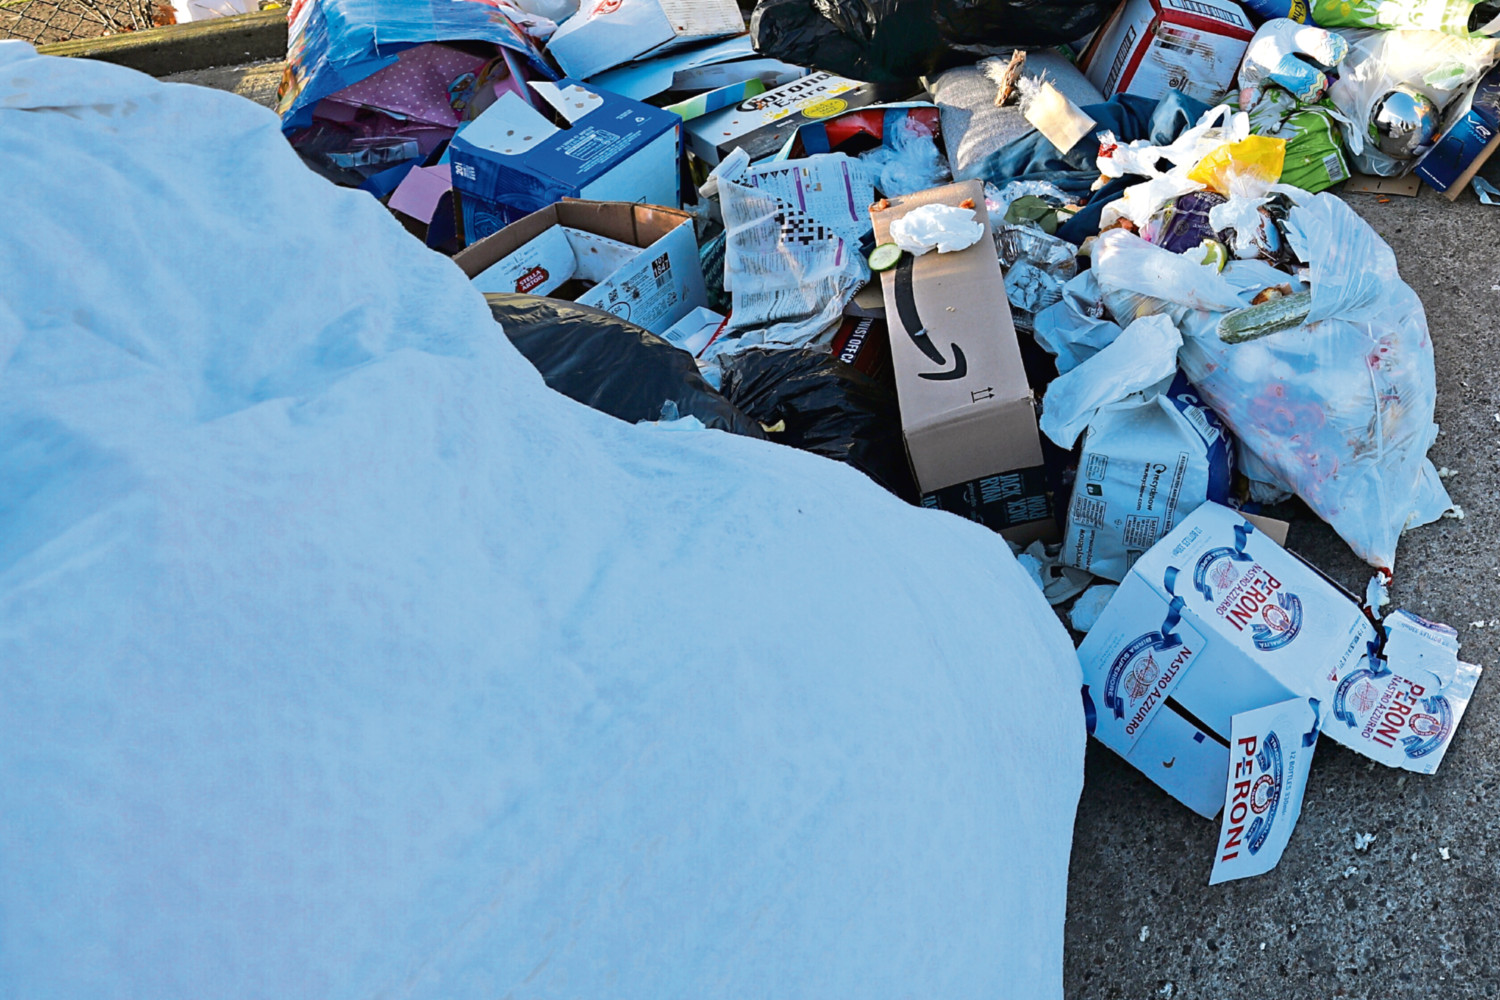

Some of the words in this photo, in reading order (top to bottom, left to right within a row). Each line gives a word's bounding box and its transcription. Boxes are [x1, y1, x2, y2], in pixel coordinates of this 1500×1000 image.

[773, 86, 828, 108] Extra
[518, 270, 543, 287] STELLA
[521, 275, 545, 293] ARTOIS
[654, 261, 669, 278] 1847
[847, 339, 862, 353] OFF
[979, 477, 1002, 504] RYAN
[1000, 473, 1022, 498] JACK
[1240, 562, 1263, 587] NASTRO
[1215, 583, 1244, 616] AZZURRO
[1225, 570, 1282, 632] PERONI
[1107, 652, 1131, 698] SUPERIORE
[1157, 646, 1193, 690] NASTRO
[1379, 674, 1404, 704] NASTRO
[1126, 686, 1163, 735] AZZURRO
[1361, 702, 1388, 739] AZZURRO
[1372, 679, 1426, 749] PERONI
[1221, 735, 1257, 863] PERONI
